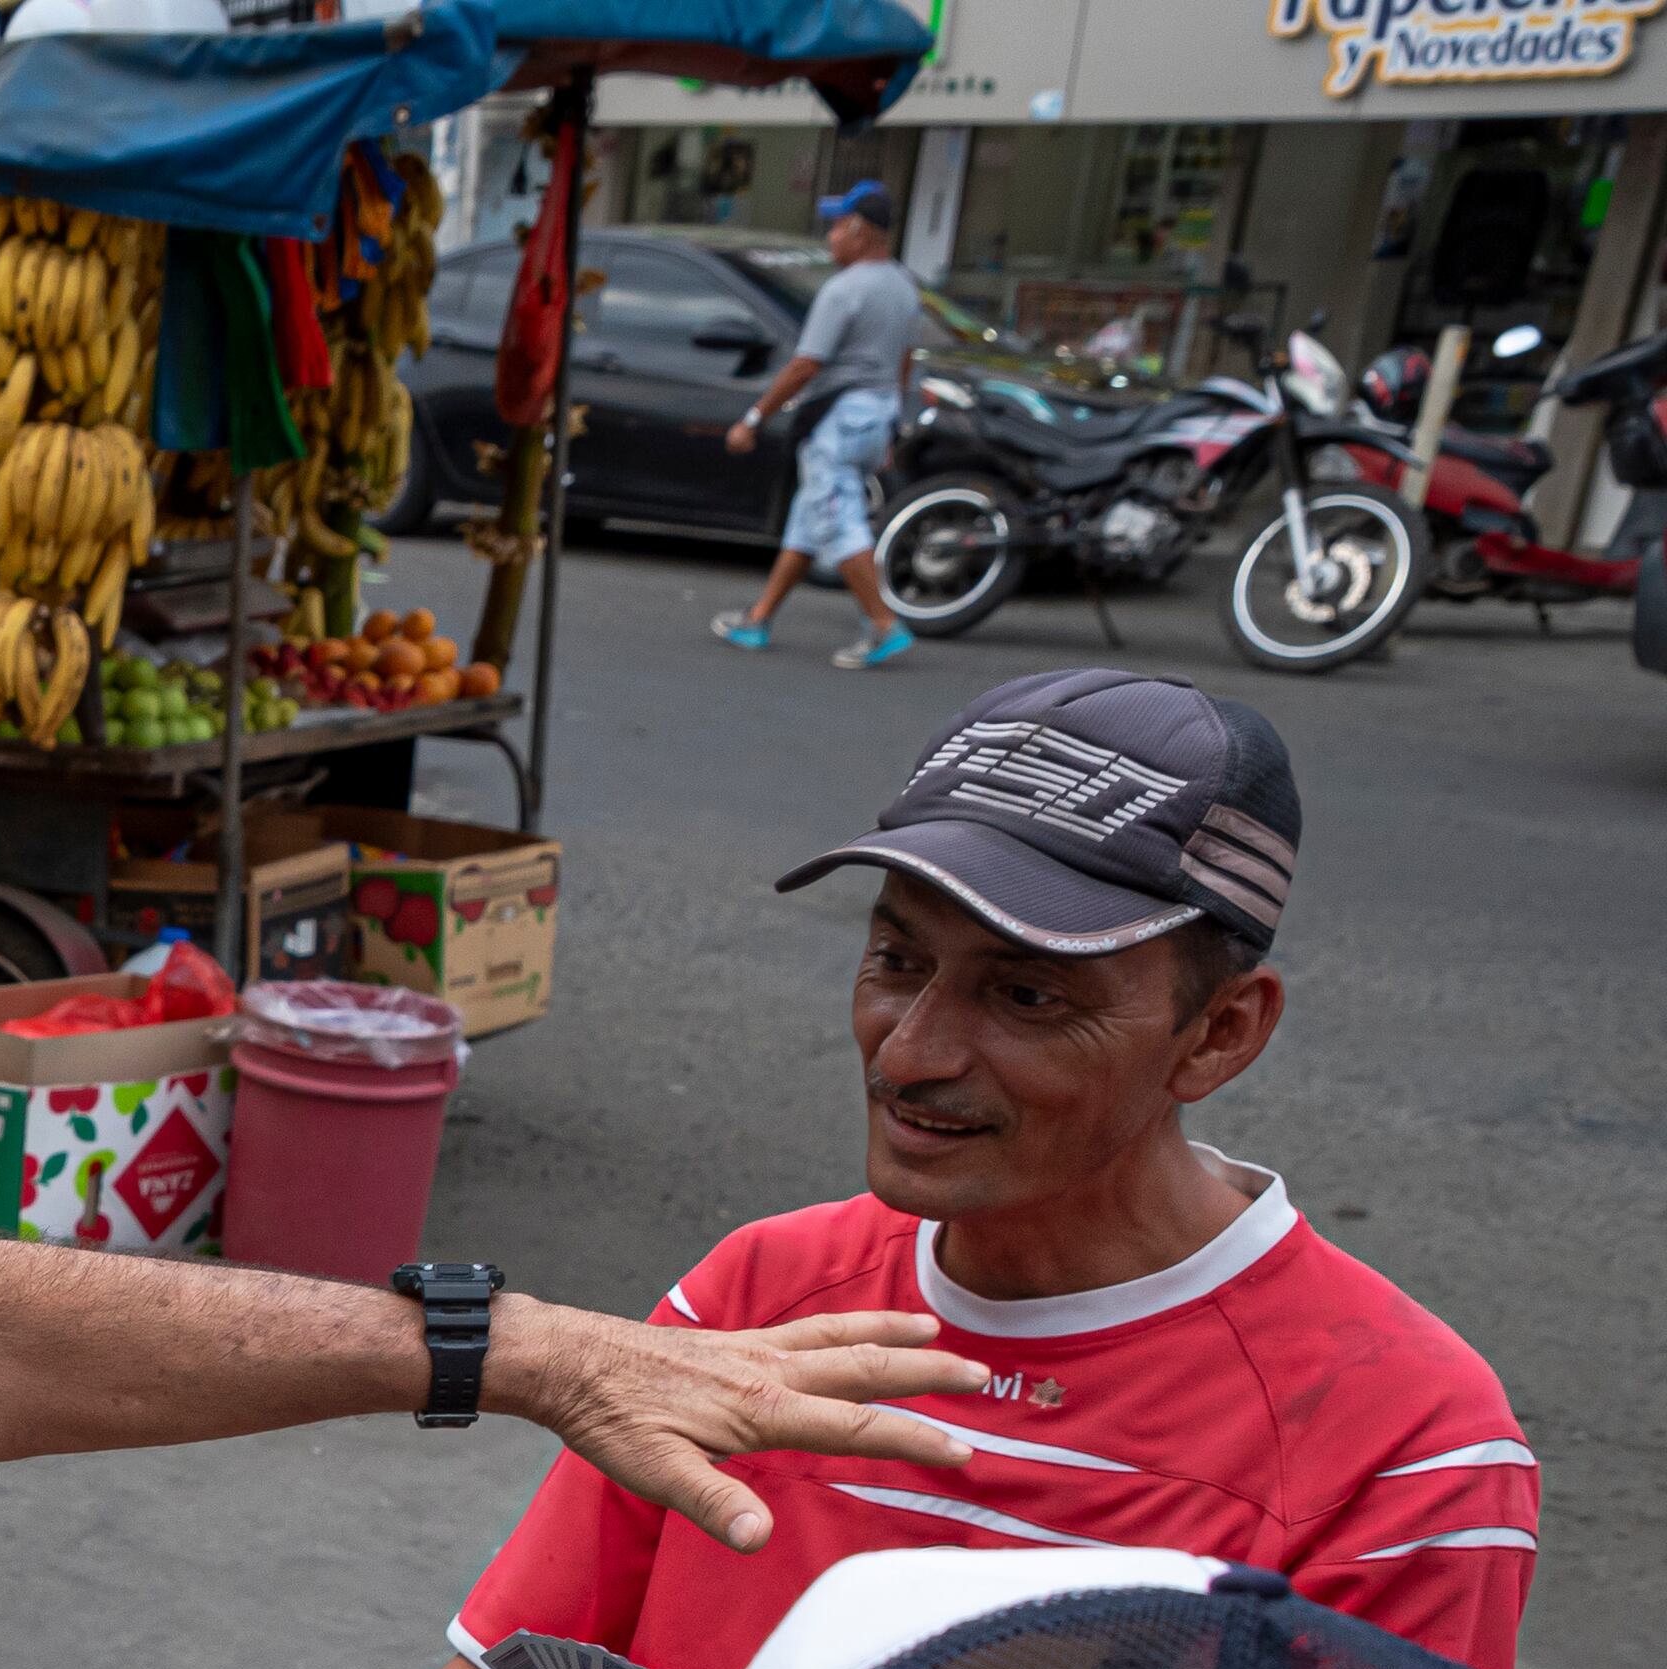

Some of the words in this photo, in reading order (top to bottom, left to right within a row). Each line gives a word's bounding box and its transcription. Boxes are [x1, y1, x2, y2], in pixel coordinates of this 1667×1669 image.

[1340, 42, 1361, 84] y
[1391, 20, 1617, 68] Novedades
[1045, 938, 1100, 953] adidas
